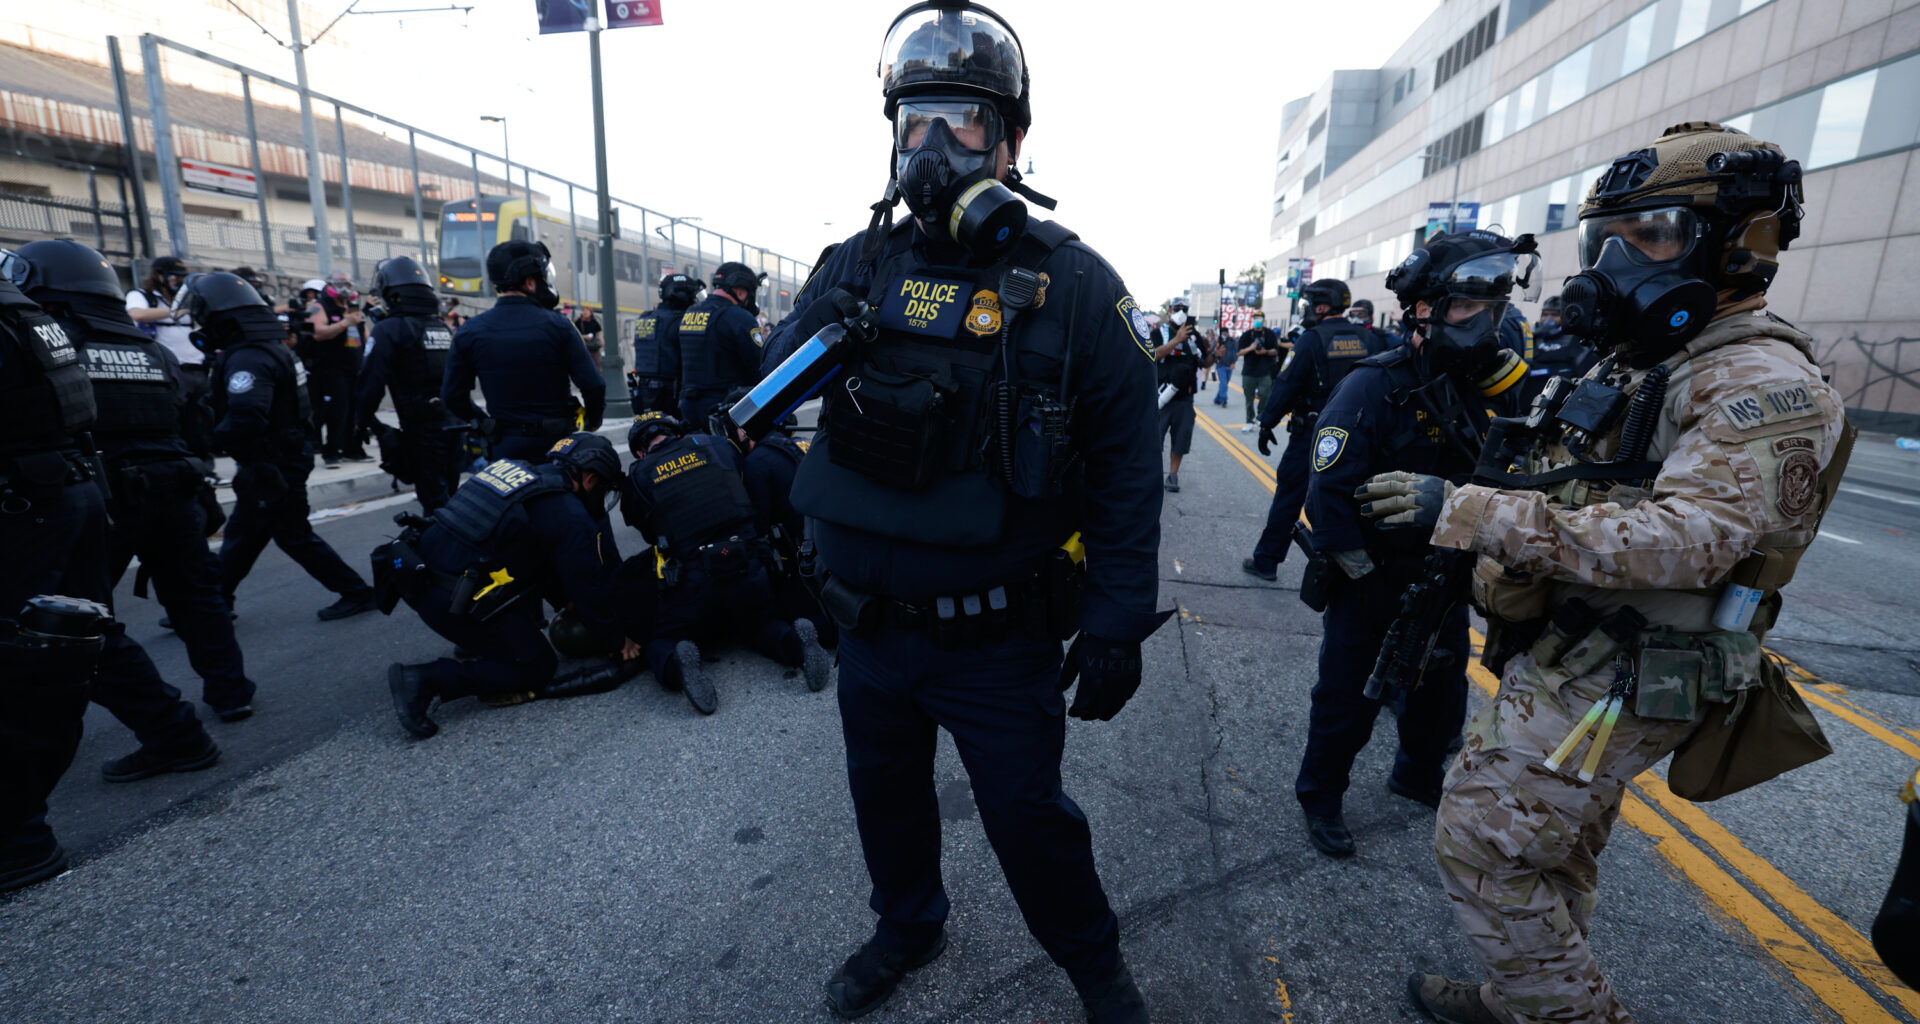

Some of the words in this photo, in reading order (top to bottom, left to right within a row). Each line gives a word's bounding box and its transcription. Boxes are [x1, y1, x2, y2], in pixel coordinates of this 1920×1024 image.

[900, 279, 959, 303] POLICE
[681, 312, 710, 325] POLICE
[904, 299, 940, 320] DHS
[86, 348, 151, 366] POLICE
[87, 371, 117, 379] ORDER
[101, 365, 147, 373] CUSTOMS
[1728, 397, 1765, 423] NS
[1765, 386, 1815, 415] 1022
[1320, 430, 1346, 440] POLICE
[1782, 440, 1807, 448] SRT
[656, 452, 699, 476] POLICE
[484, 458, 535, 489] POLICE
